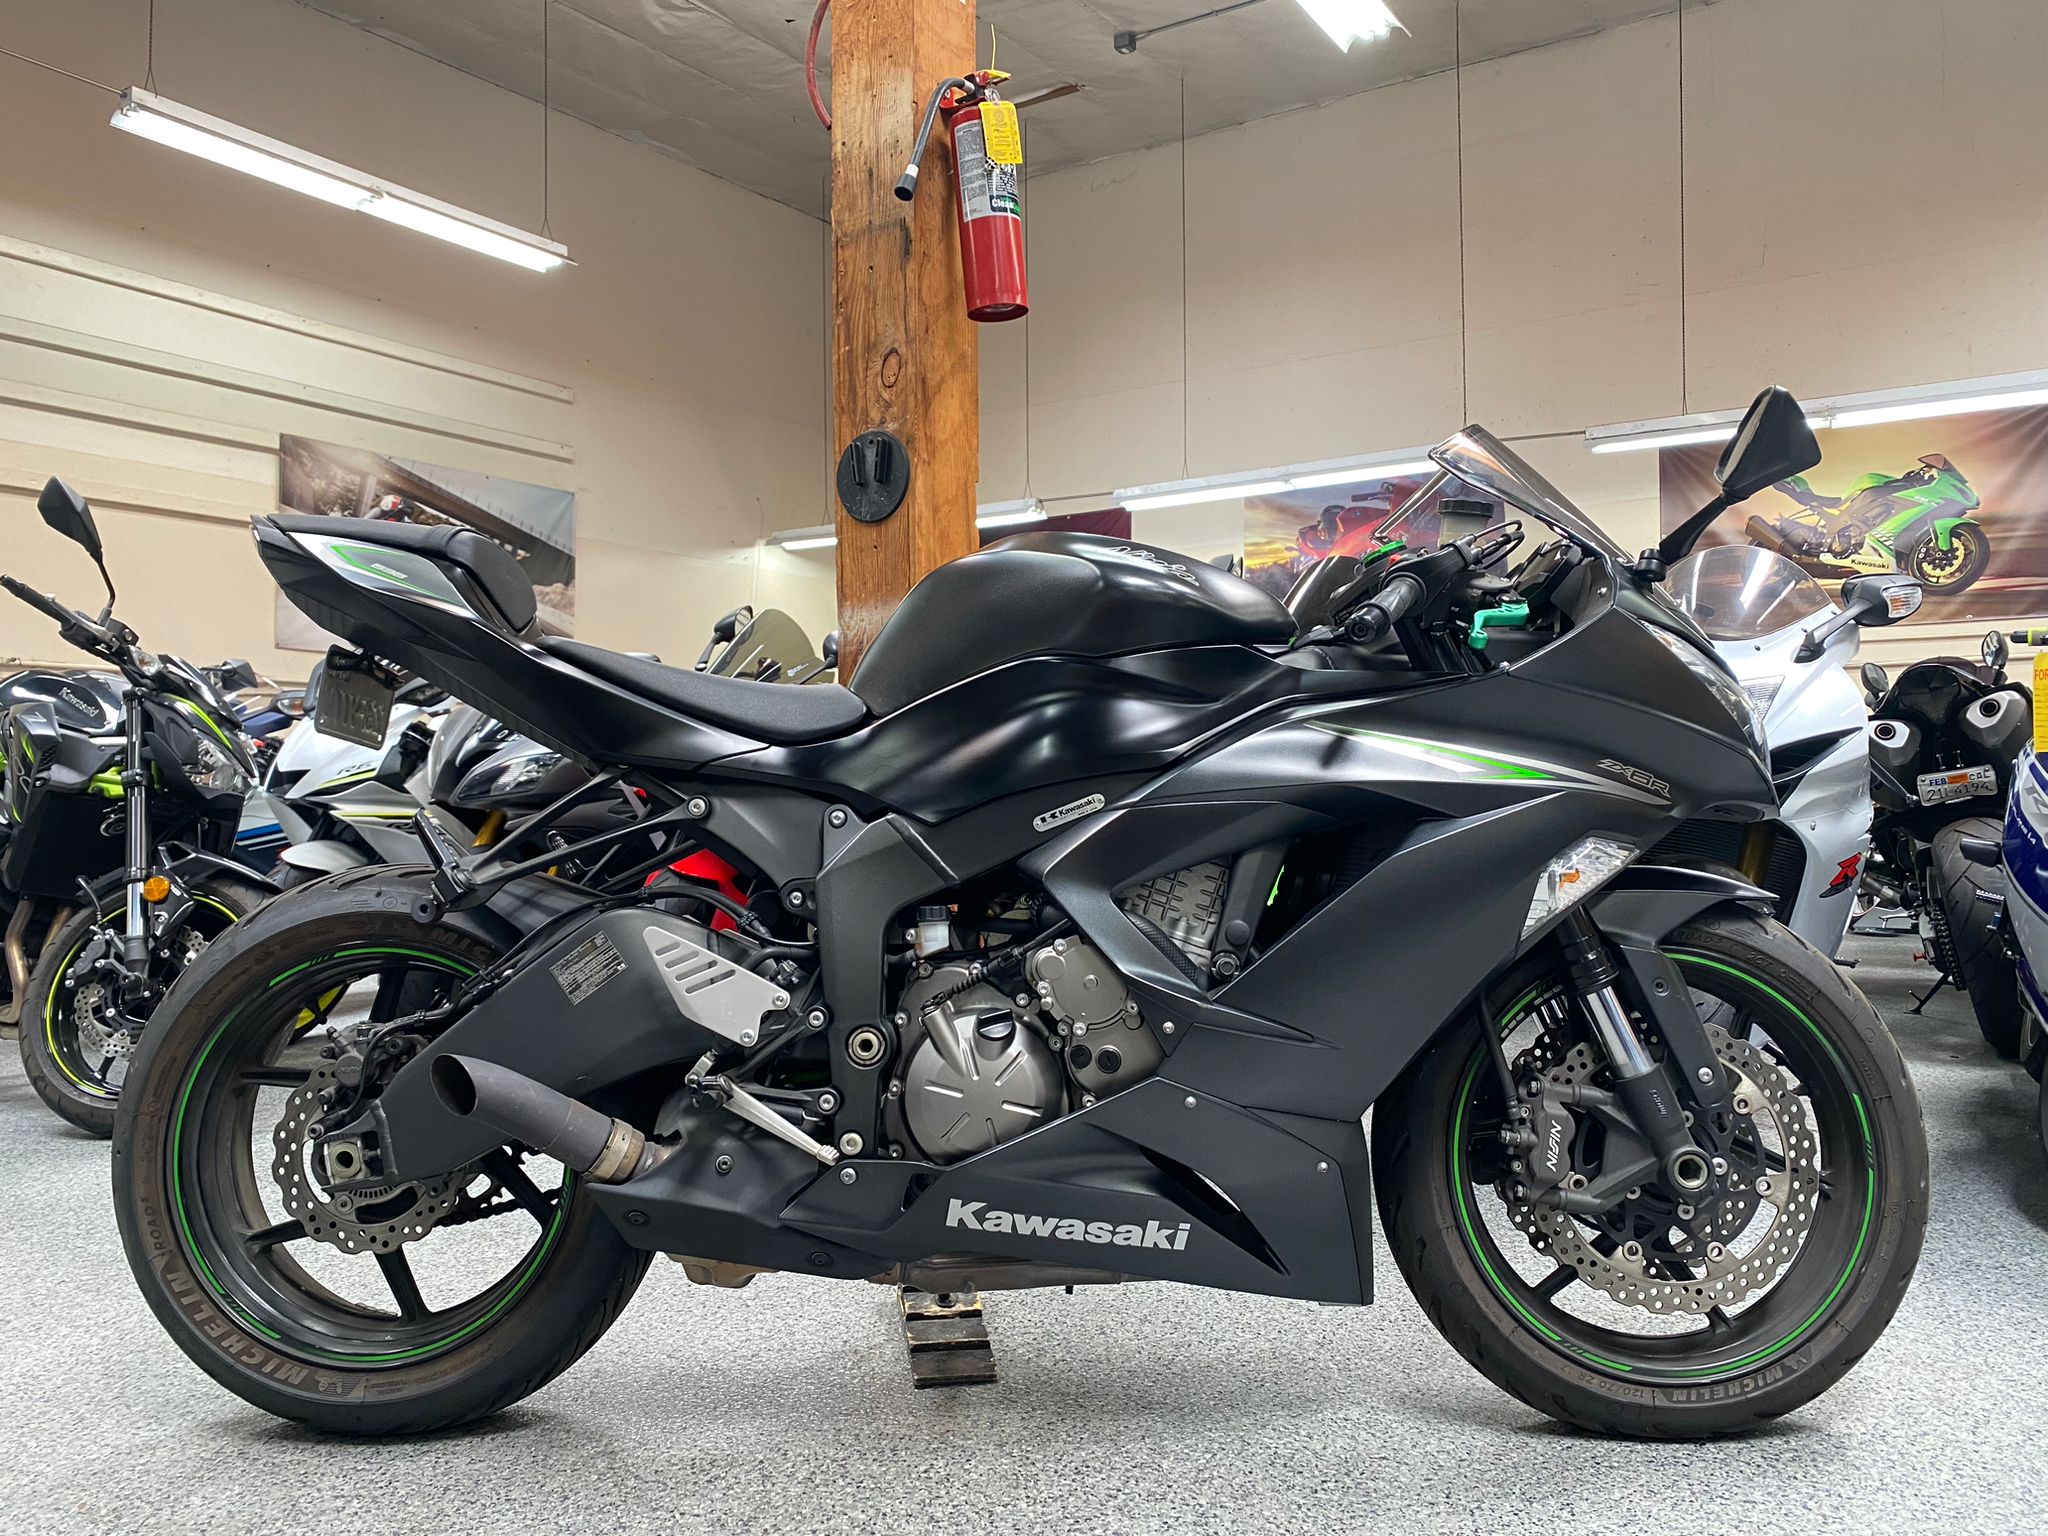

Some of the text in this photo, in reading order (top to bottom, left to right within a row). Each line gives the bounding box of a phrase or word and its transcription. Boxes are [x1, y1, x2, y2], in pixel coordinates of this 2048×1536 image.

[1850, 559, 1890, 570] Kawasaki
[1929, 777, 1948, 787] FEB
[1058, 796, 1097, 817] Kawasaki
[945, 1198, 1192, 1251] Kawasaki
[166, 1271, 310, 1386] MICHELIN
[1671, 1365, 1785, 1401] MICHELIN
